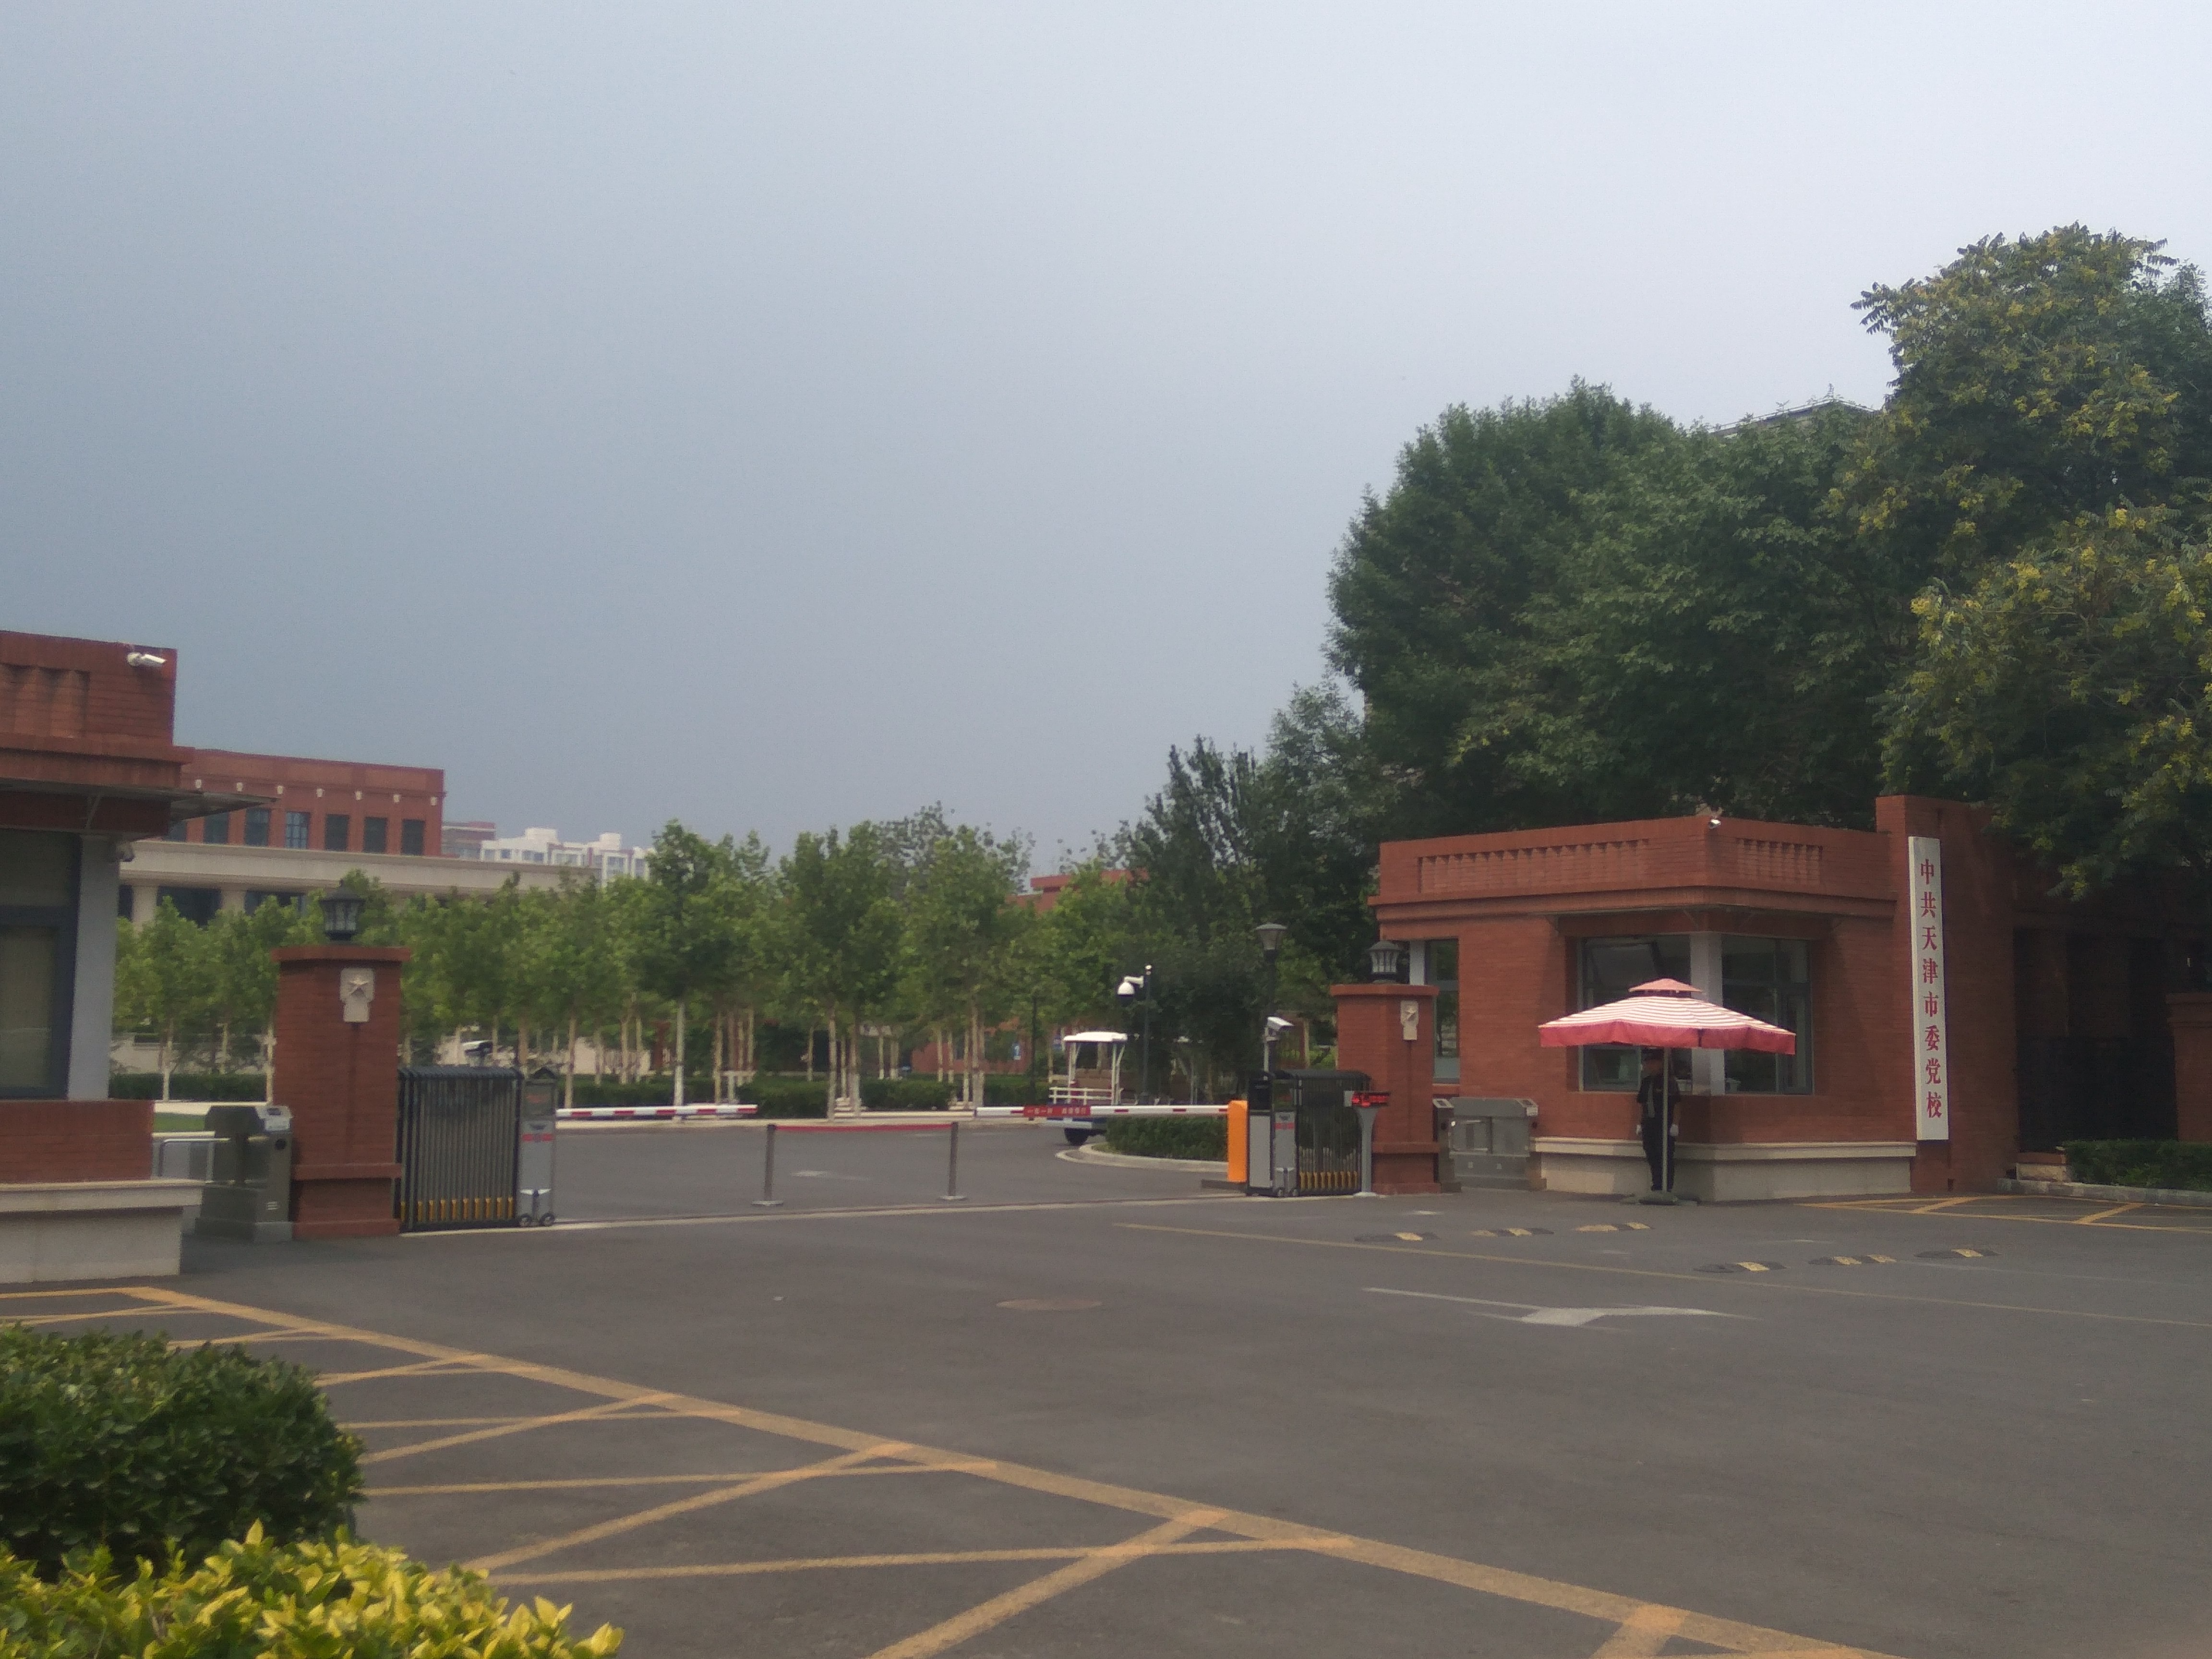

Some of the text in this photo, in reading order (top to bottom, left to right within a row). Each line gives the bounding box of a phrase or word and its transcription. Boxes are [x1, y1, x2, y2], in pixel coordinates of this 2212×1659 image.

[1921, 859, 1942, 1118] 中共天津市委党校
